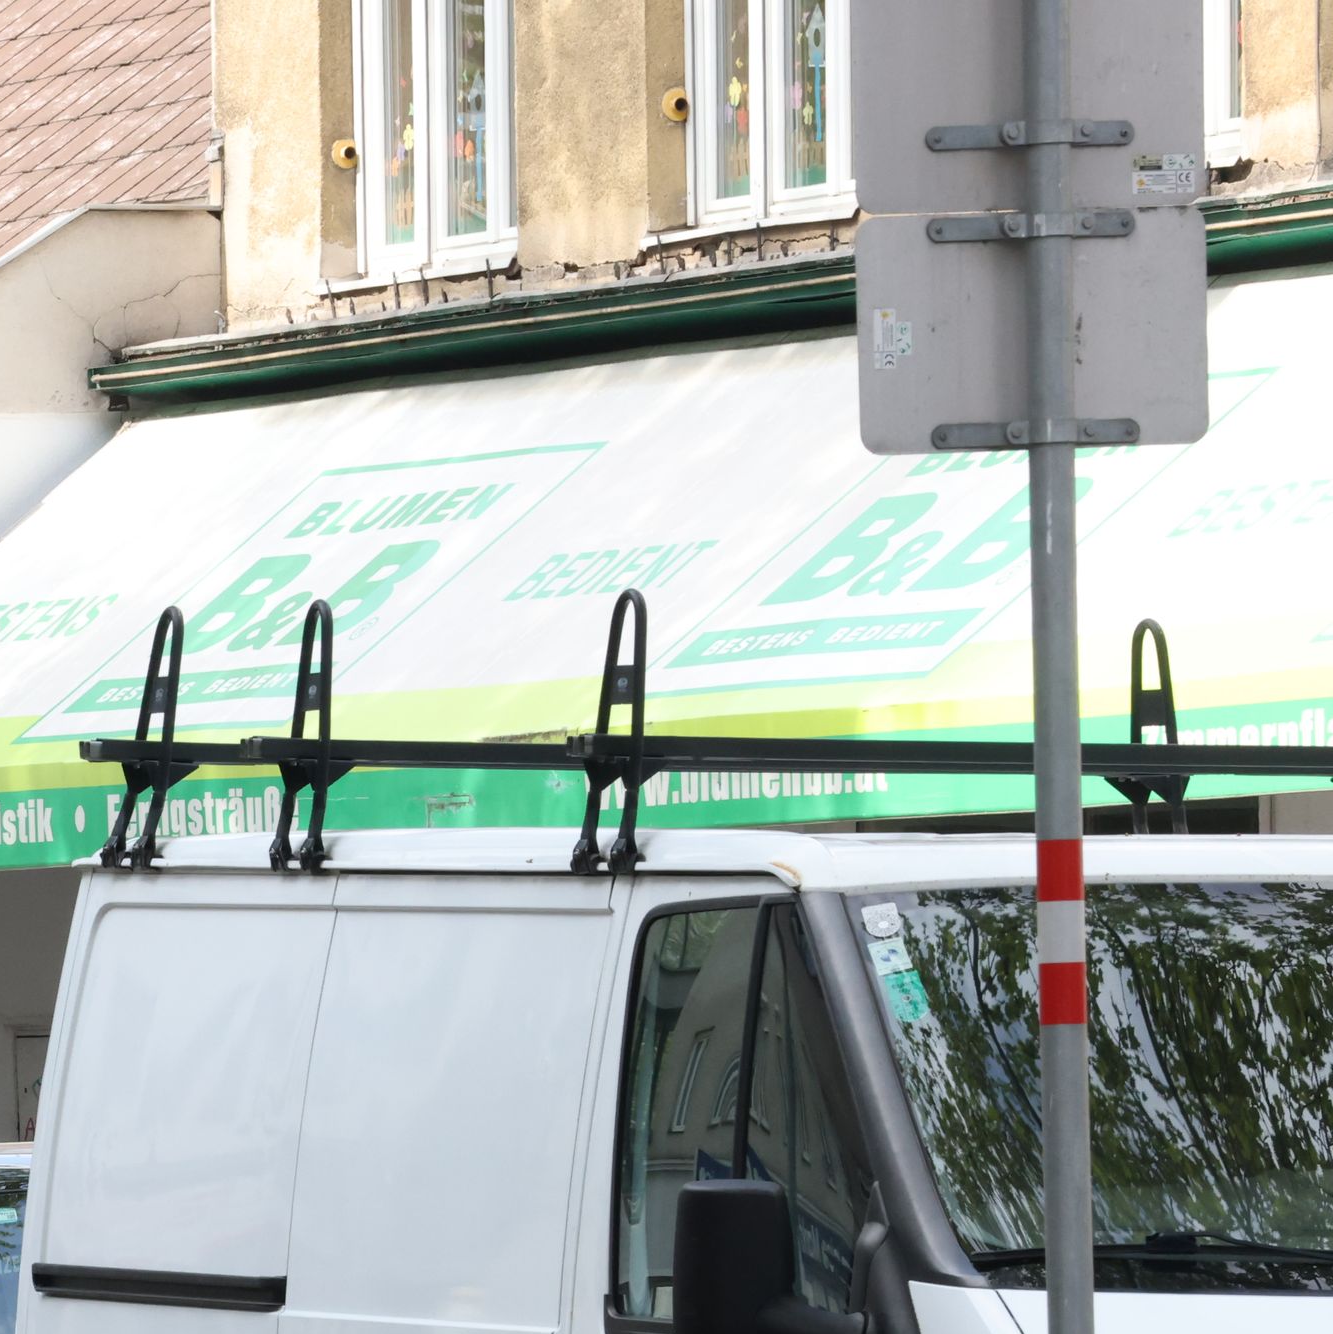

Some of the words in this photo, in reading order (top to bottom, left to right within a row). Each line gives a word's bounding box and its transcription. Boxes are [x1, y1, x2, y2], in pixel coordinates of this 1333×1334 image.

[283, 482, 517, 540] BLUMEN
[501, 539, 721, 601] BEDIENT
[700, 630, 816, 657] BESTENS
[824, 620, 946, 645] BEDIENT
[96, 681, 196, 704] BESS
[201, 671, 299, 695] BEDIENT
